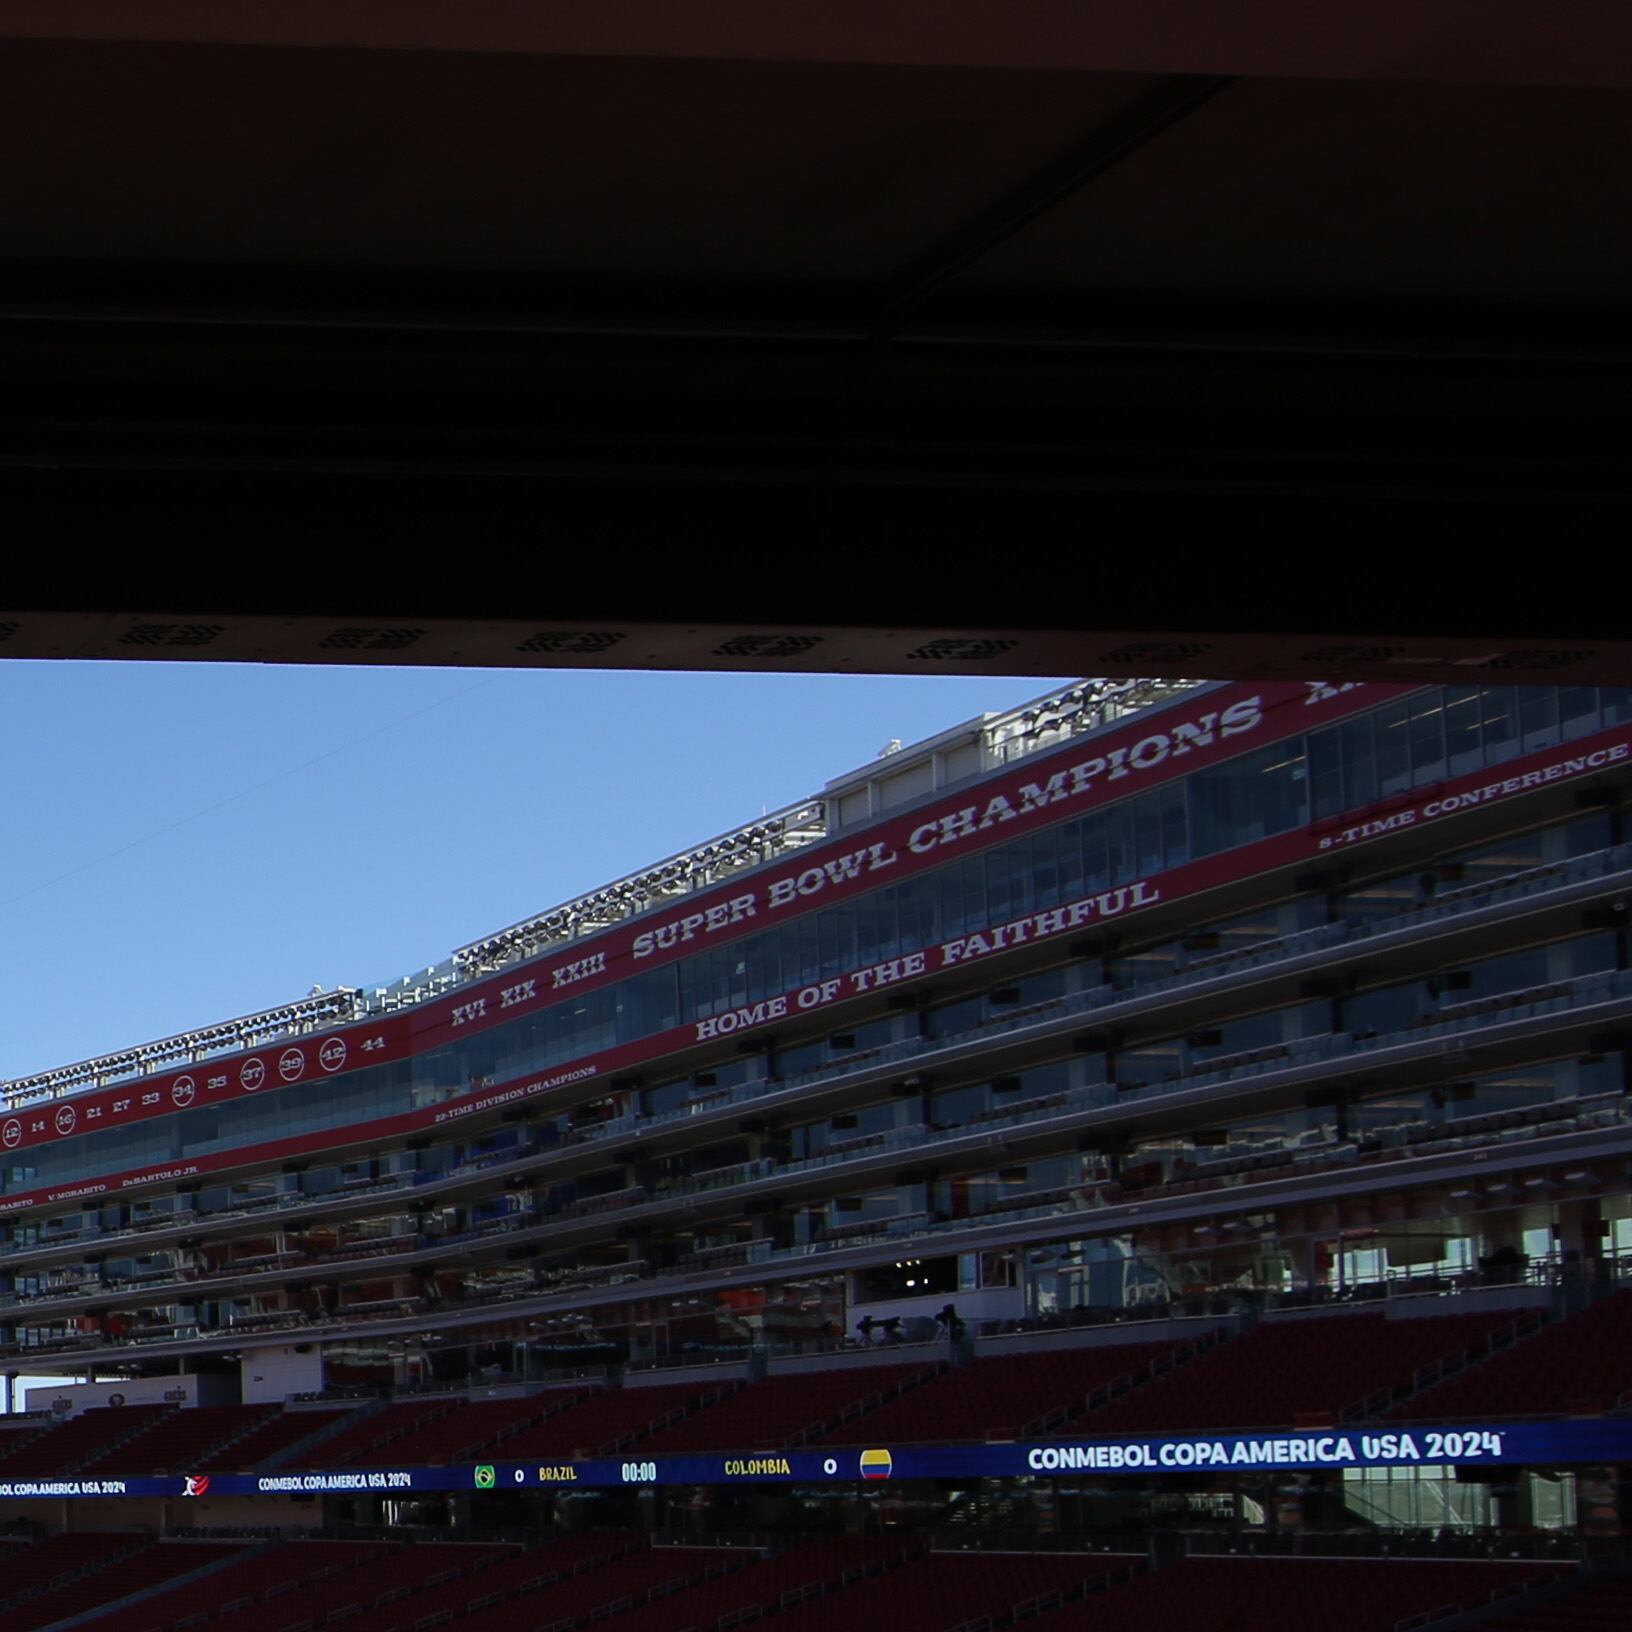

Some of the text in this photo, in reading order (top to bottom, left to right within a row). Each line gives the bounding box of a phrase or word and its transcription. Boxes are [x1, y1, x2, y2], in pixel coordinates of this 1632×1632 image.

[1319, 743, 1630, 849] 8-TIME CONFERENCE
[452, 696, 1264, 1026] XVI XIX XXIII SUPER BOWL CHAMPIONS
[696, 880, 1159, 1041] HOME OF THE FAITHFUL
[207, 1075, 227, 1089] 35
[475, 1087, 524, 1109] DIVISION
[527, 1065, 598, 1094] CHAMPIONS
[113, 1099, 131, 1112] 27
[514, 1458, 837, 1482] 0 BRAZIL 00:00 COLOMBIA 0
[1028, 1432, 1502, 1470] CONMEBOL COPA AMERICA USA 2024
[258, 1472, 411, 1491] CONMEBOL COPA AMERICA USA 2024
